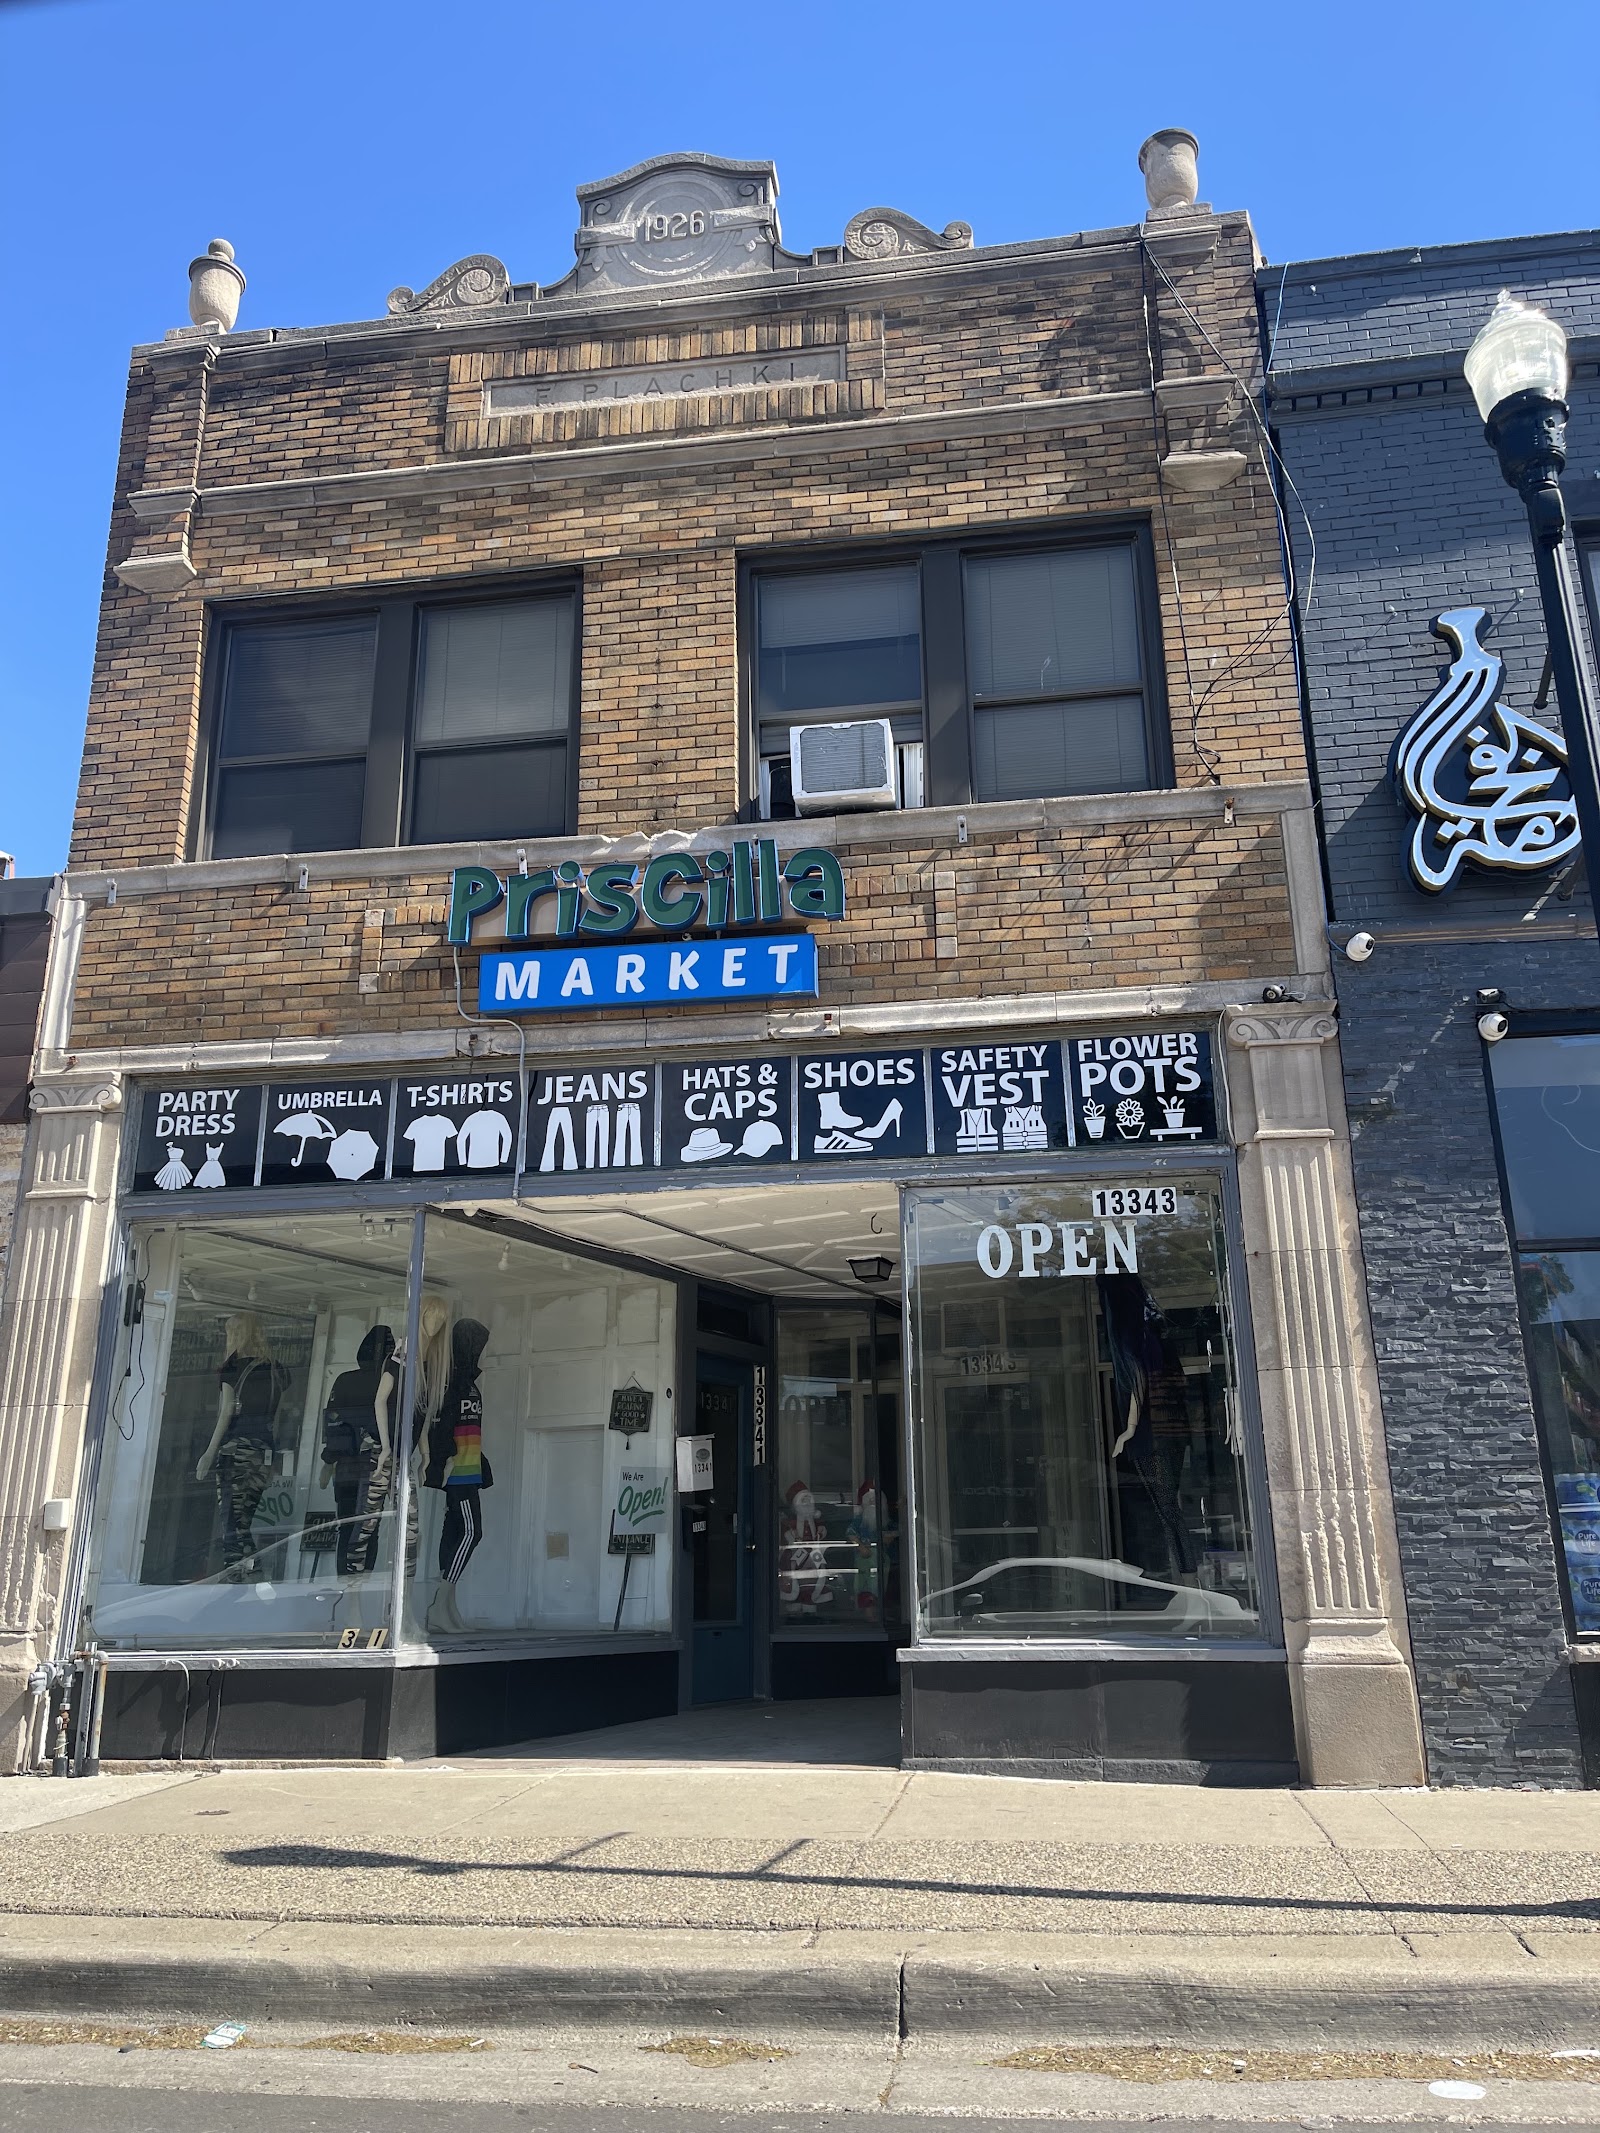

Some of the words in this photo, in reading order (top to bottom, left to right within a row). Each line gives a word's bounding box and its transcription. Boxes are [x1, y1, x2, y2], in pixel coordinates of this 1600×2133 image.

[637, 210, 705, 241] 1926
[583, 362, 794, 402] PLACHKI
[495, 944, 798, 1001] MARKET
[941, 1045, 1047, 1073] SAFETY
[1077, 1032, 1198, 1062] FLOWER
[537, 1070, 647, 1105] JEANS
[682, 1065, 750, 1091] HATS
[757, 1063, 778, 1086] &
[804, 1058, 915, 1089] SHOES
[942, 1070, 1049, 1107] VEST
[1080, 1056, 1201, 1097] POTS
[158, 1089, 240, 1113] PARTY
[278, 1089, 383, 1110] UMBRELLA
[407, 1080, 513, 1108] T-SHIRTS
[684, 1088, 778, 1121] CAPS
[155, 1113, 236, 1137] DRESS
[1096, 1188, 1176, 1216] 13343
[977, 1219, 1139, 1278] OPEN
[620, 1417, 639, 1427] TIME
[755, 1366, 765, 1464] 13341
[622, 1472, 632, 1480] We
[633, 1472, 644, 1481] Are
[618, 1477, 668, 1521] Open!
[1578, 1532, 1597, 1541] Pure
[1581, 1540, 1596, 1549] Life
